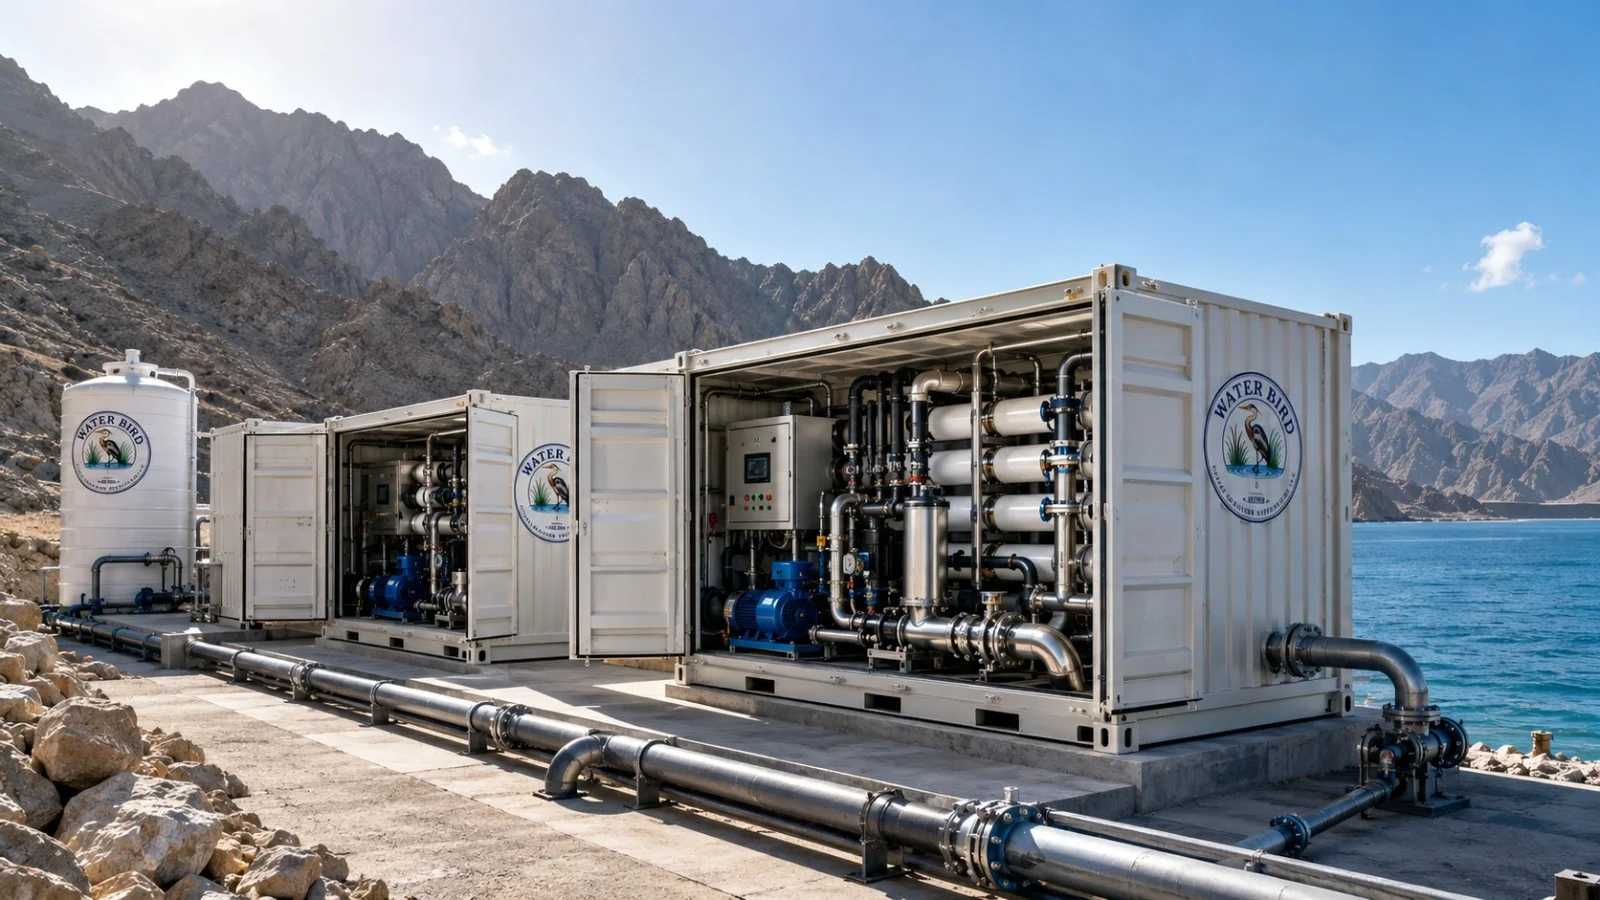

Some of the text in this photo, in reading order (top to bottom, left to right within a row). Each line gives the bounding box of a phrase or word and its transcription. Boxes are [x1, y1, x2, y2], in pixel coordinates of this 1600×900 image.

[1214, 379, 1295, 435] WATER BIRD
[77, 415, 144, 445] WATER BIRD
[522, 448, 564, 477] WATER
